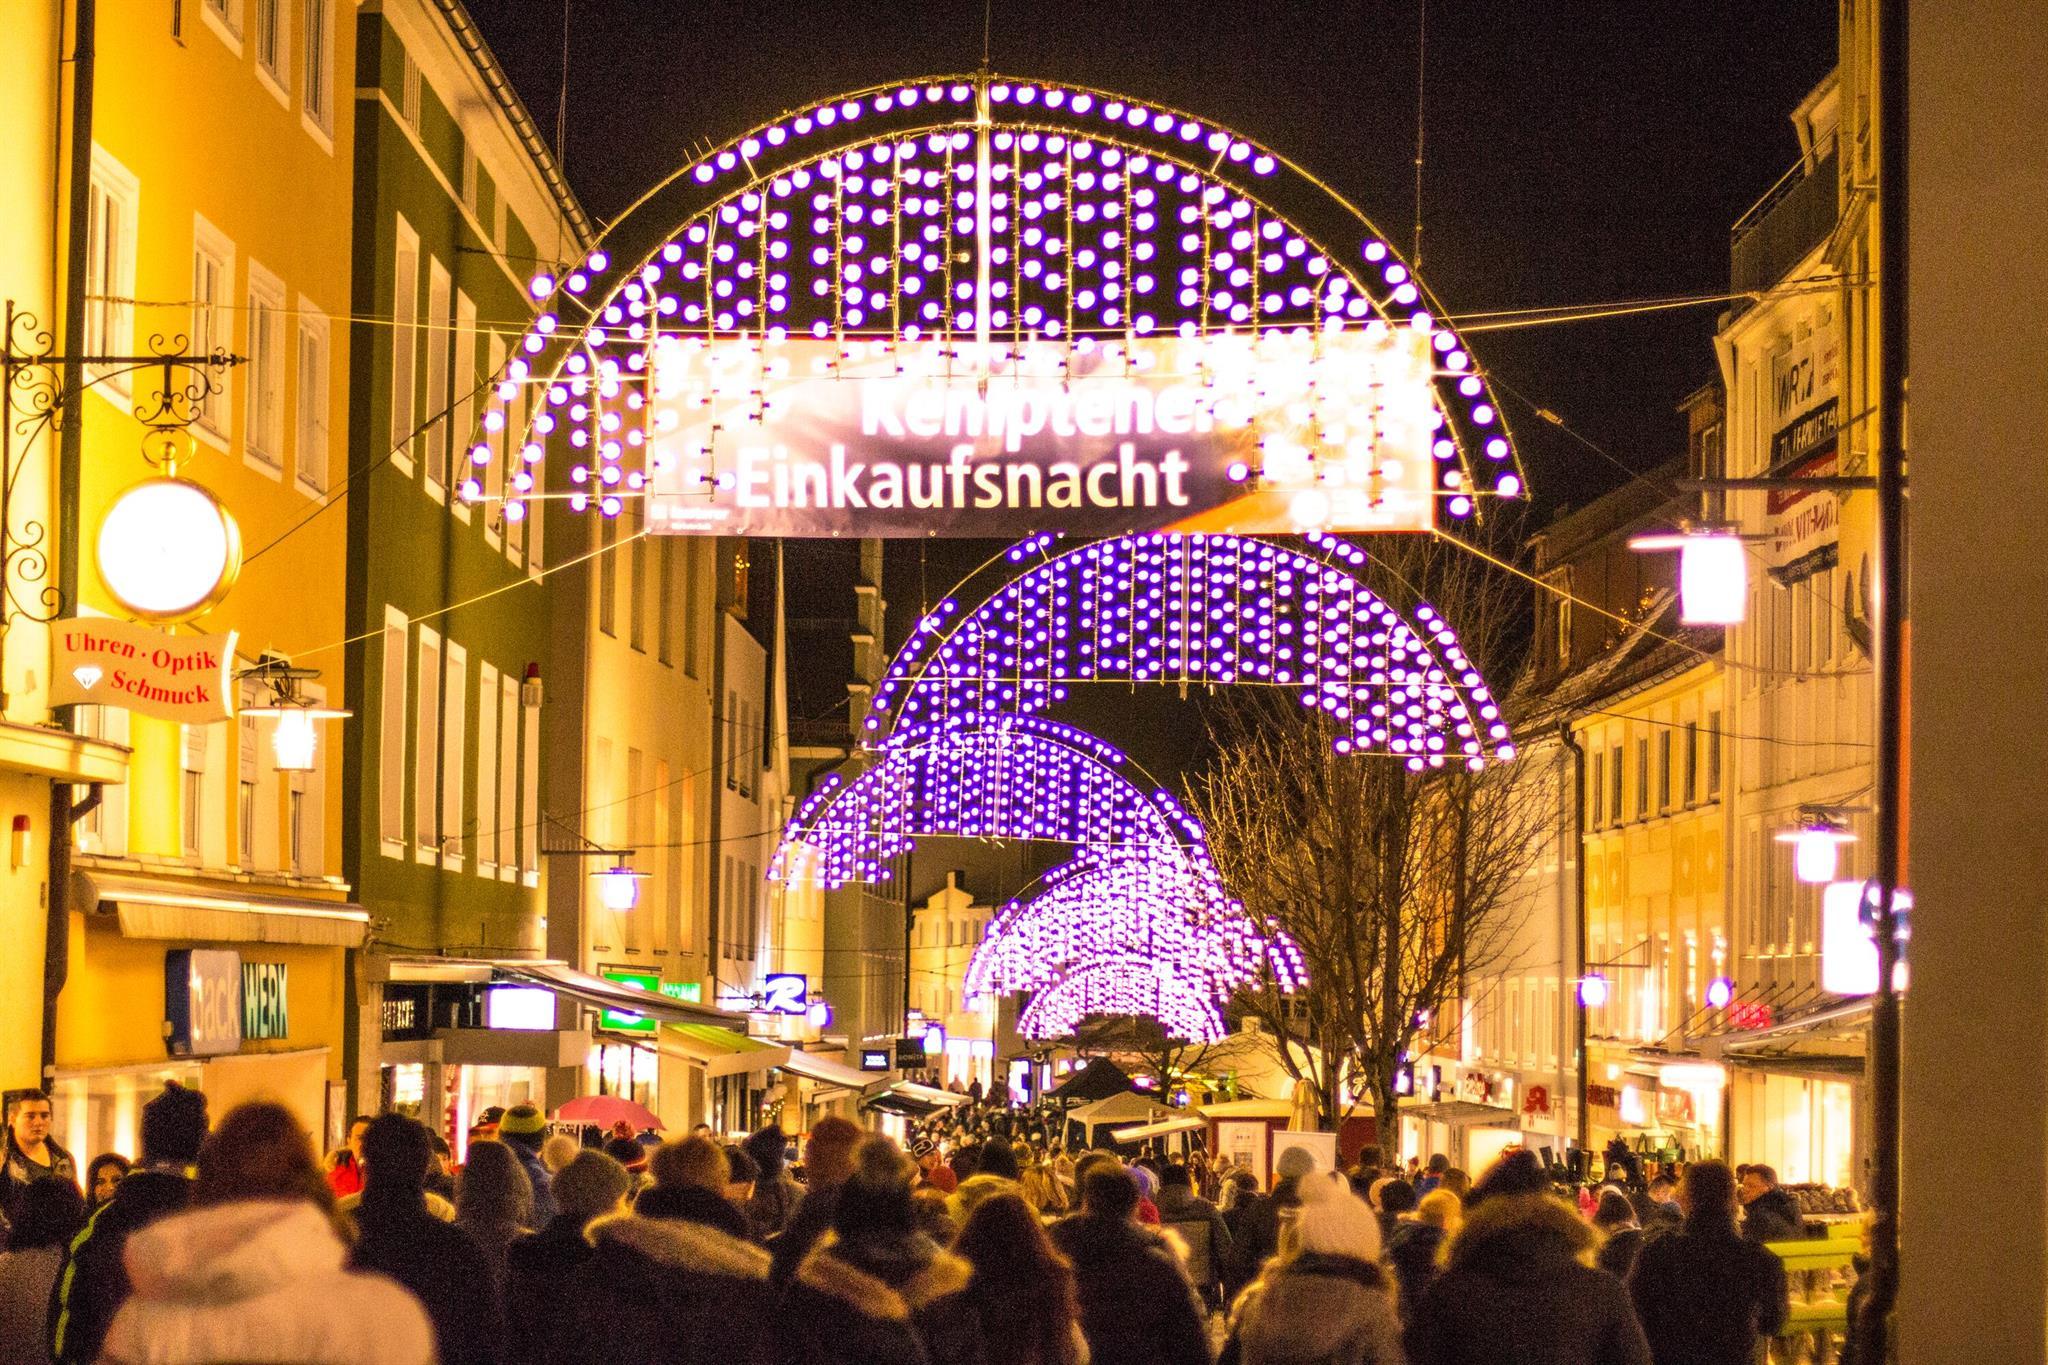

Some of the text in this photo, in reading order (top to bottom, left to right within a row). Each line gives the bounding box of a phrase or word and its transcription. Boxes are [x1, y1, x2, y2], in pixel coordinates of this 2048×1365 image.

[735, 441, 1190, 509] Einkaufsnacht
[64, 632, 218, 676] Uhren Optik
[110, 669, 211, 705] Schmuck
[242, 963, 288, 1040] WERK
